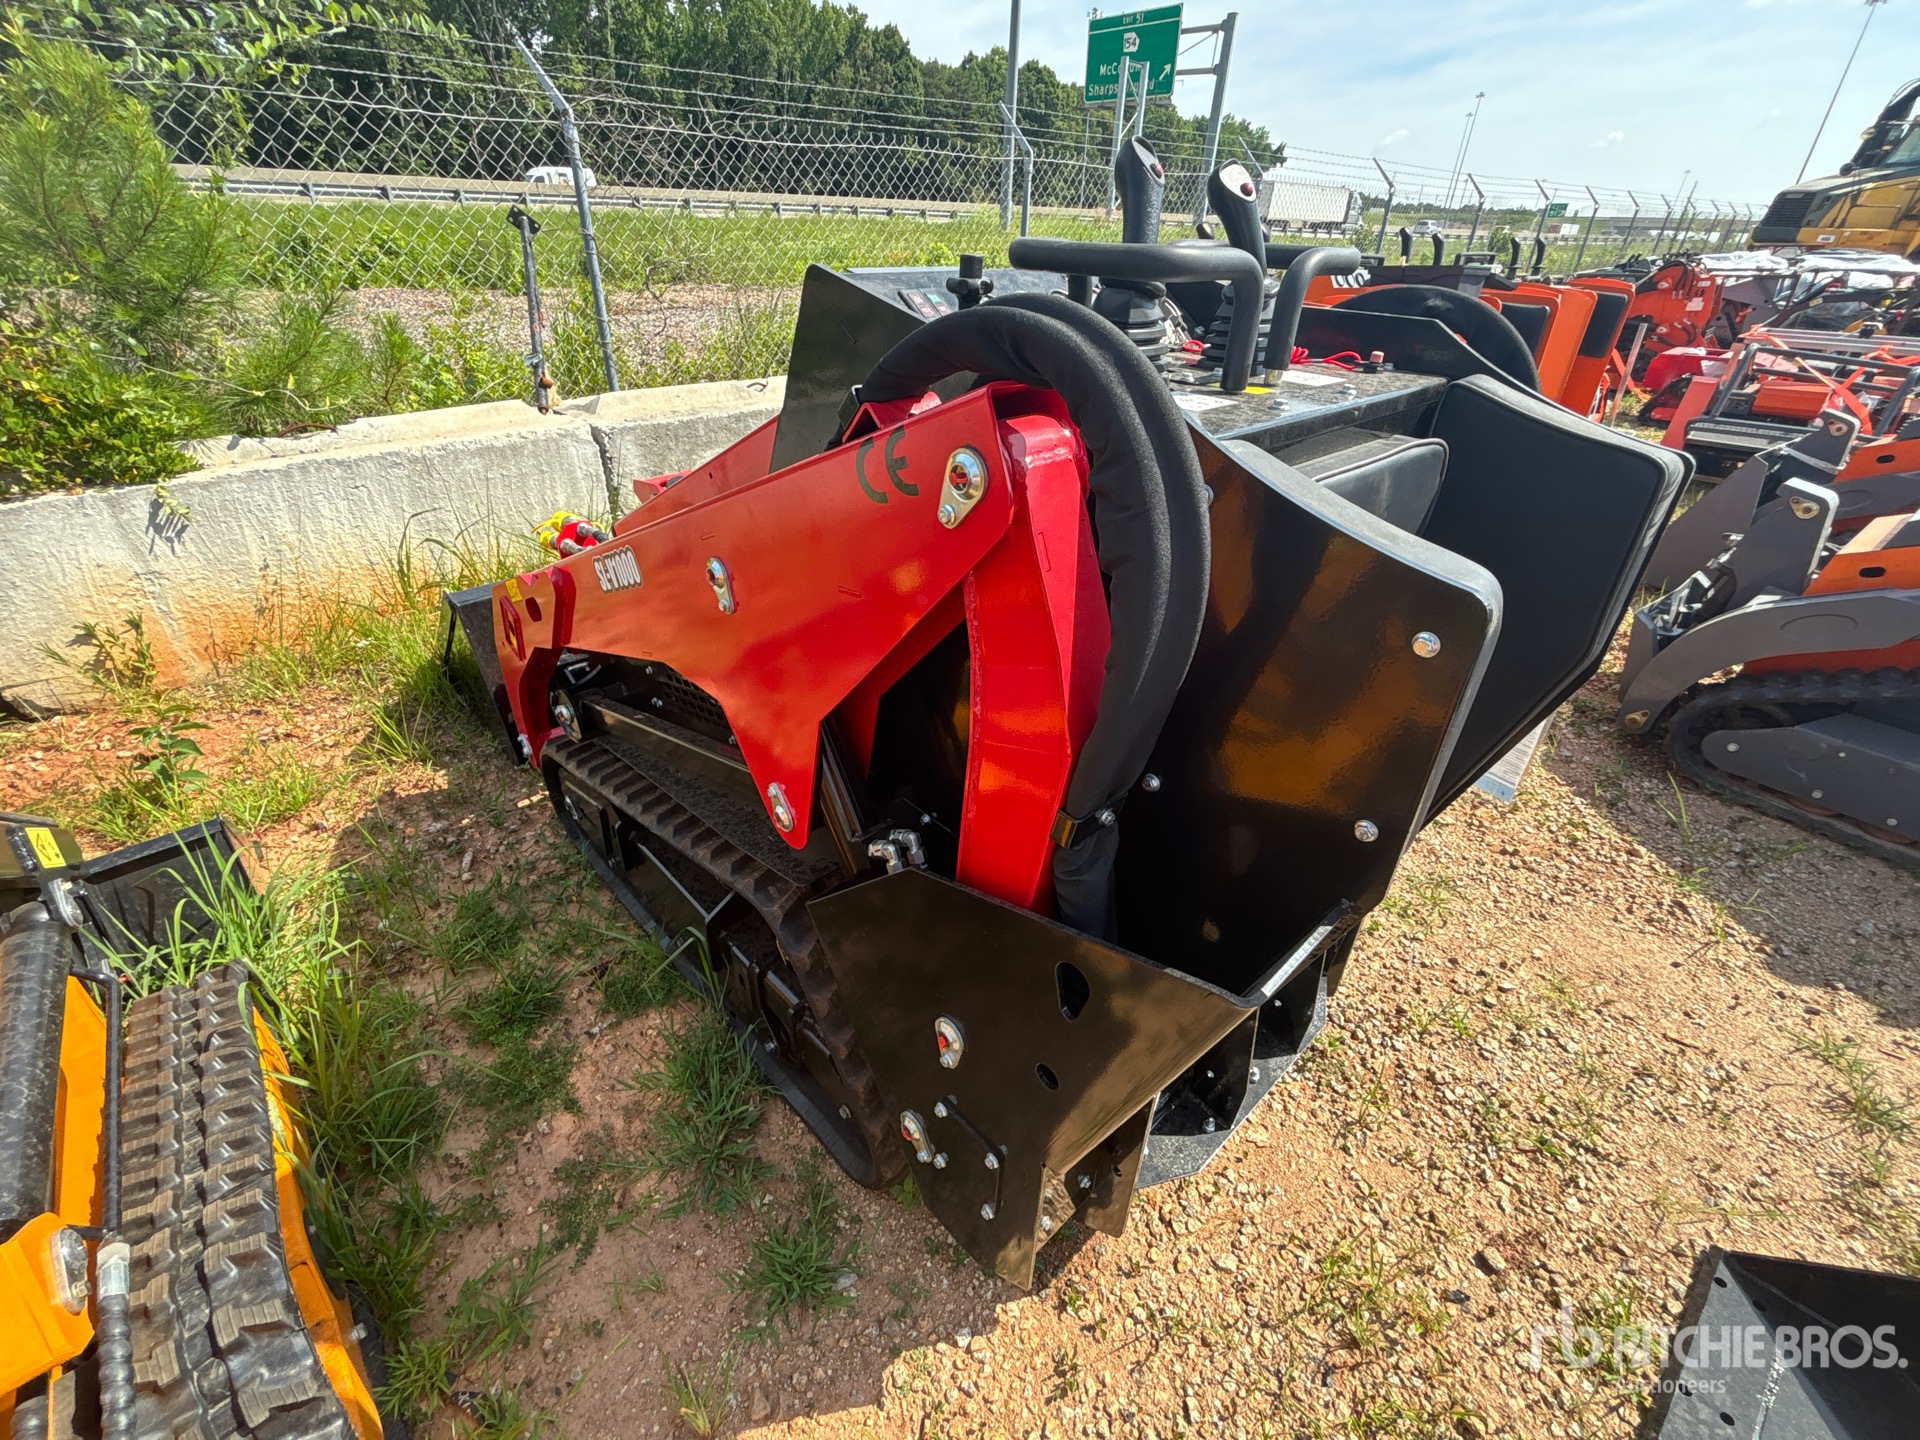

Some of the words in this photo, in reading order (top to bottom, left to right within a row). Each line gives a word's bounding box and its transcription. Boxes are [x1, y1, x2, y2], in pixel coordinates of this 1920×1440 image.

[1136, 12, 1145, 24] 51
[1124, 36, 1138, 50] 154
[1099, 62, 1143, 76] McCum
[856, 424, 919, 504] CE
[593, 549, 641, 592] SL-V1000
